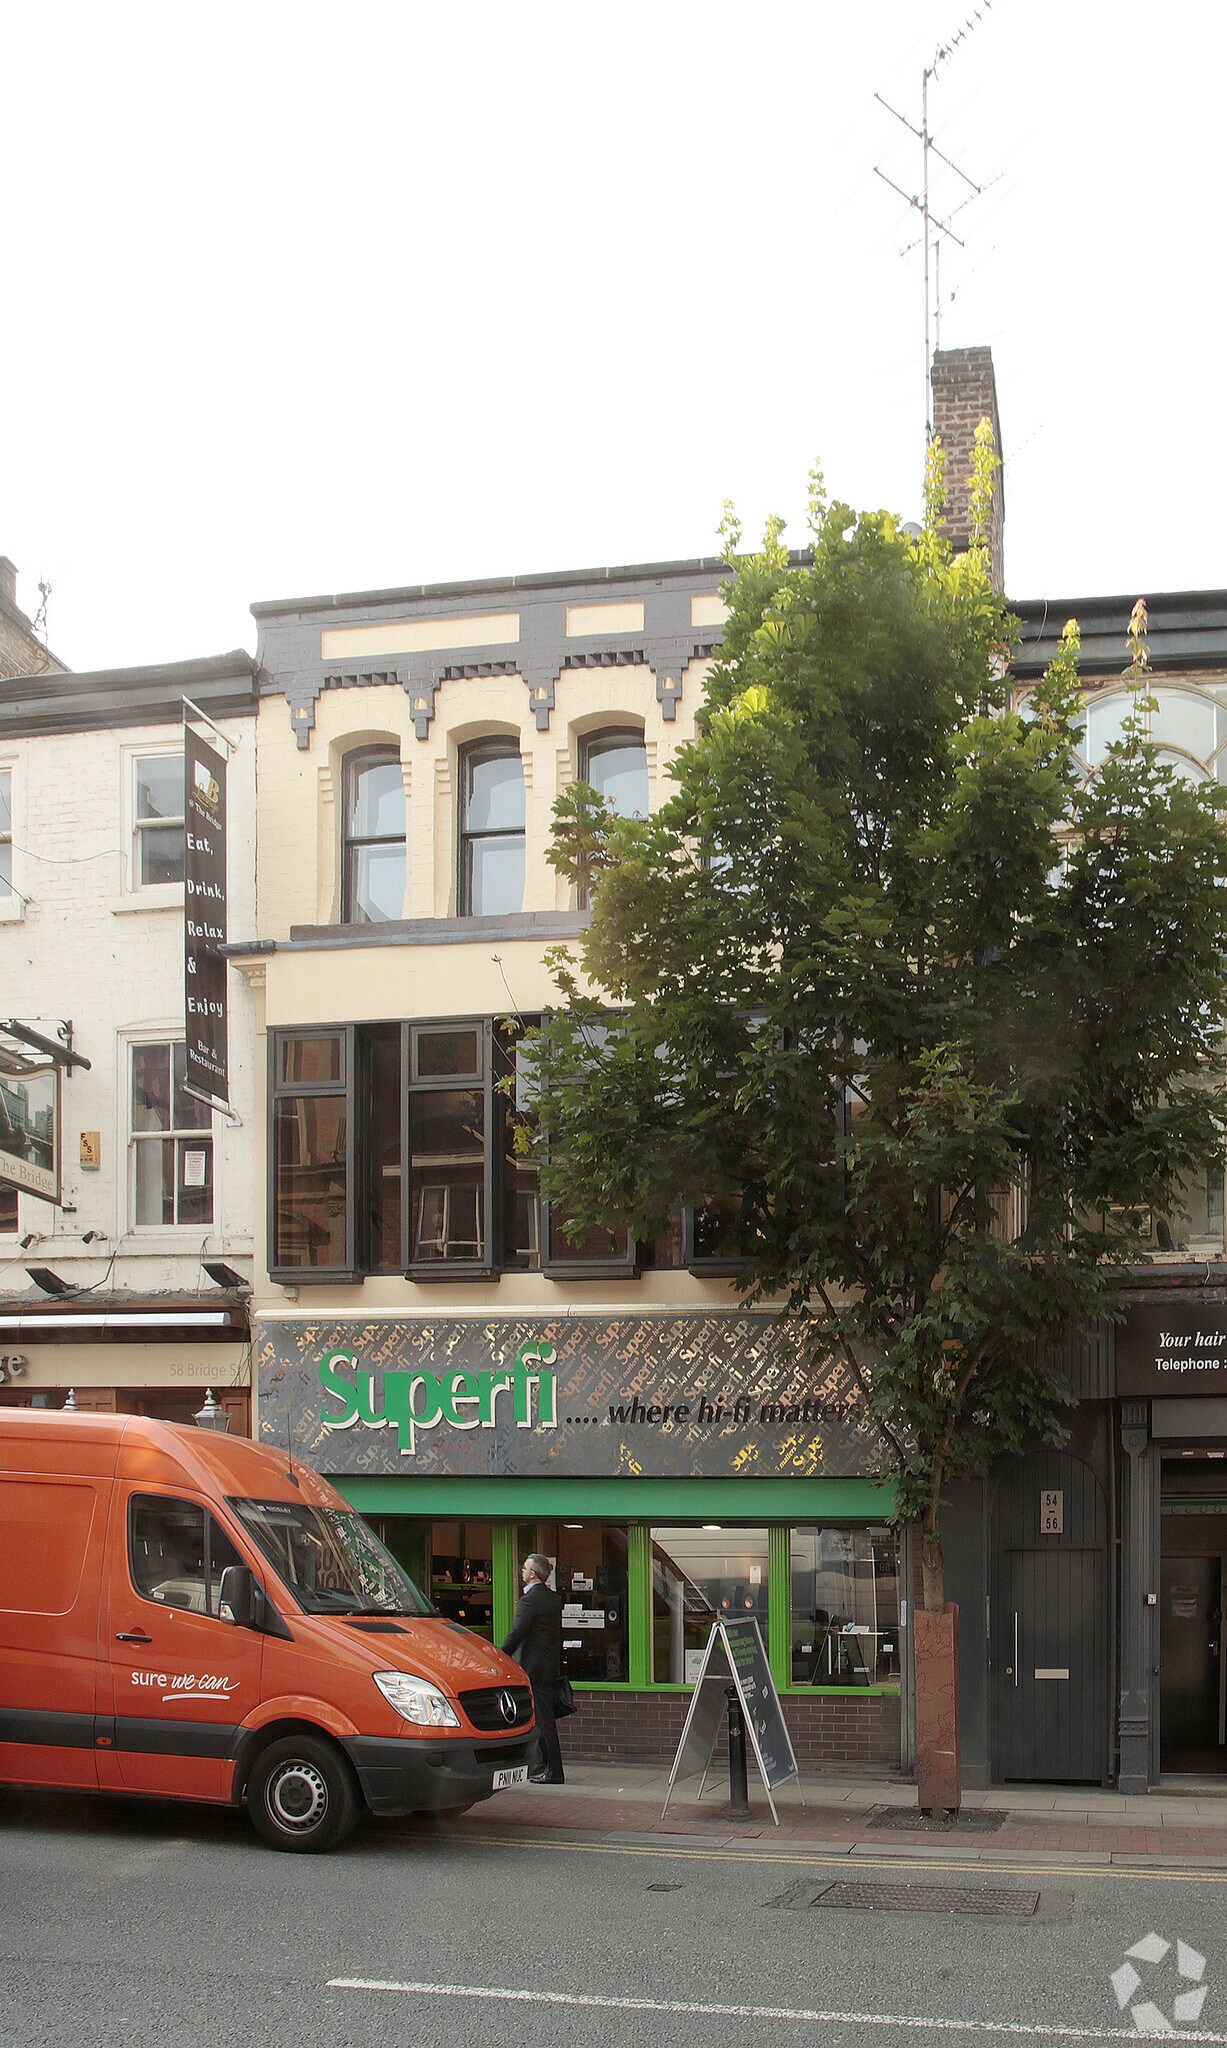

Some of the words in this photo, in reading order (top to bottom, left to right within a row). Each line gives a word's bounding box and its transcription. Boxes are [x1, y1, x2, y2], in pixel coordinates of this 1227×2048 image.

[186, 832, 214, 856] Eat,
[187, 879, 225, 901] Drink,
[187, 920, 224, 939] Relax
[187, 956, 197, 974] &
[187, 997, 223, 1018] Enjoy
[197, 1040, 209, 1055] Bar
[211, 1048, 218, 1060] &
[189, 1048, 226, 1077] Restaurant
[19, 1163, 54, 1191] Bridge
[1159, 1332, 1192, 1348] Your
[1194, 1331, 1226, 1347] hair
[169, 1363, 184, 1376] 58
[187, 1363, 226, 1379] Bridge
[1155, 1358, 1220, 1373] Telephone
[319, 1340, 557, 1455] Superfi
[609, 1397, 690, 1423] where
[697, 1396, 750, 1423] hi-fi
[1046, 1494, 1057, 1506] 54
[1046, 1517, 1058, 1529] 56
[131, 1671, 167, 1687] sure
[171, 1674, 195, 1690] we
[198, 1674, 240, 1691] can
